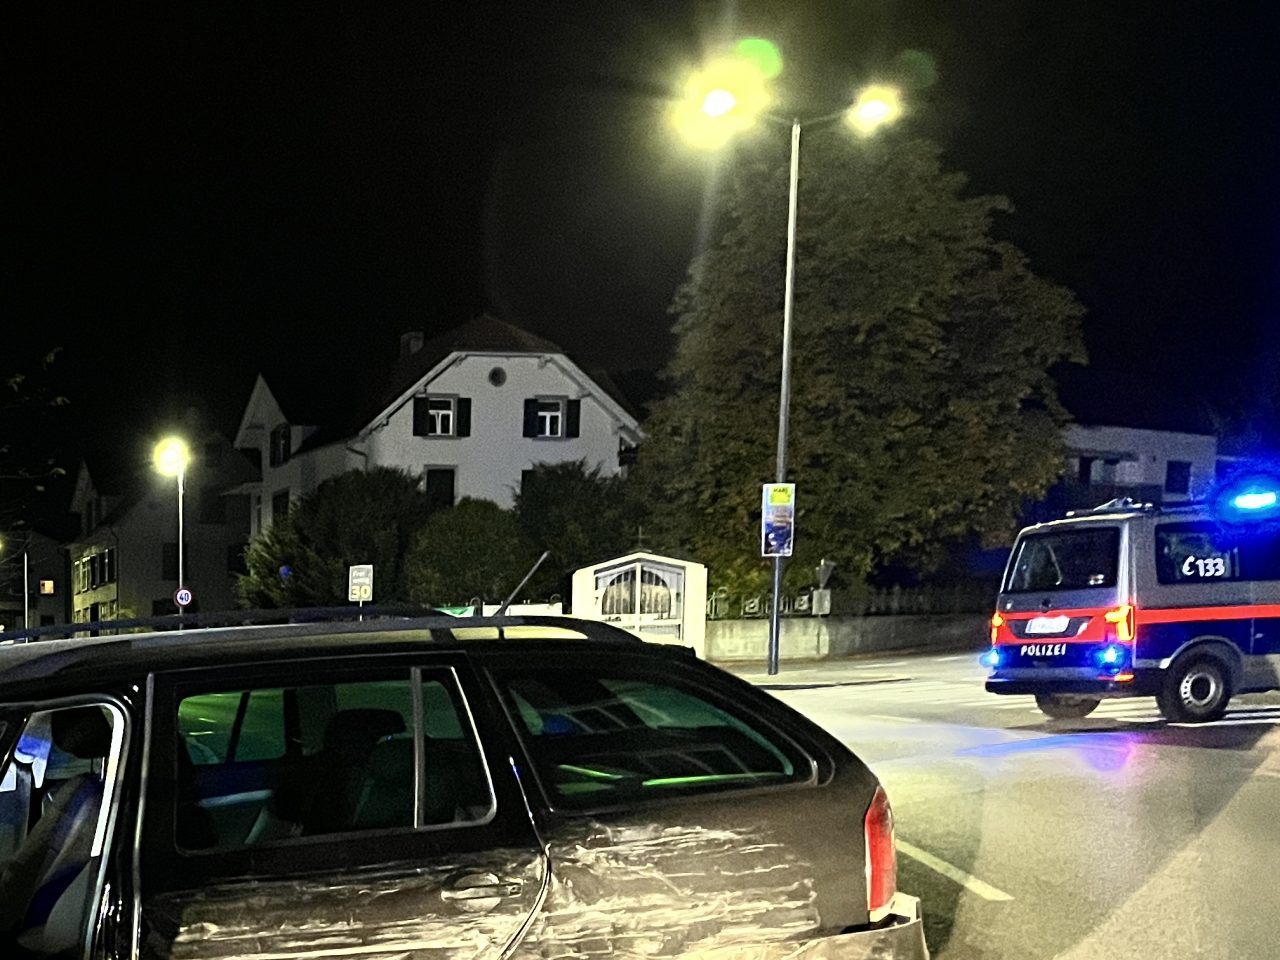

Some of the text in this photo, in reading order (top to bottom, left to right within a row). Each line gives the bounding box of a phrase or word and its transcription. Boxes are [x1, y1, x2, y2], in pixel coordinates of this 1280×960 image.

[179, 593, 189, 602] 40
[351, 585, 371, 599] 30
[1021, 643, 1067, 656] POLIZEI
